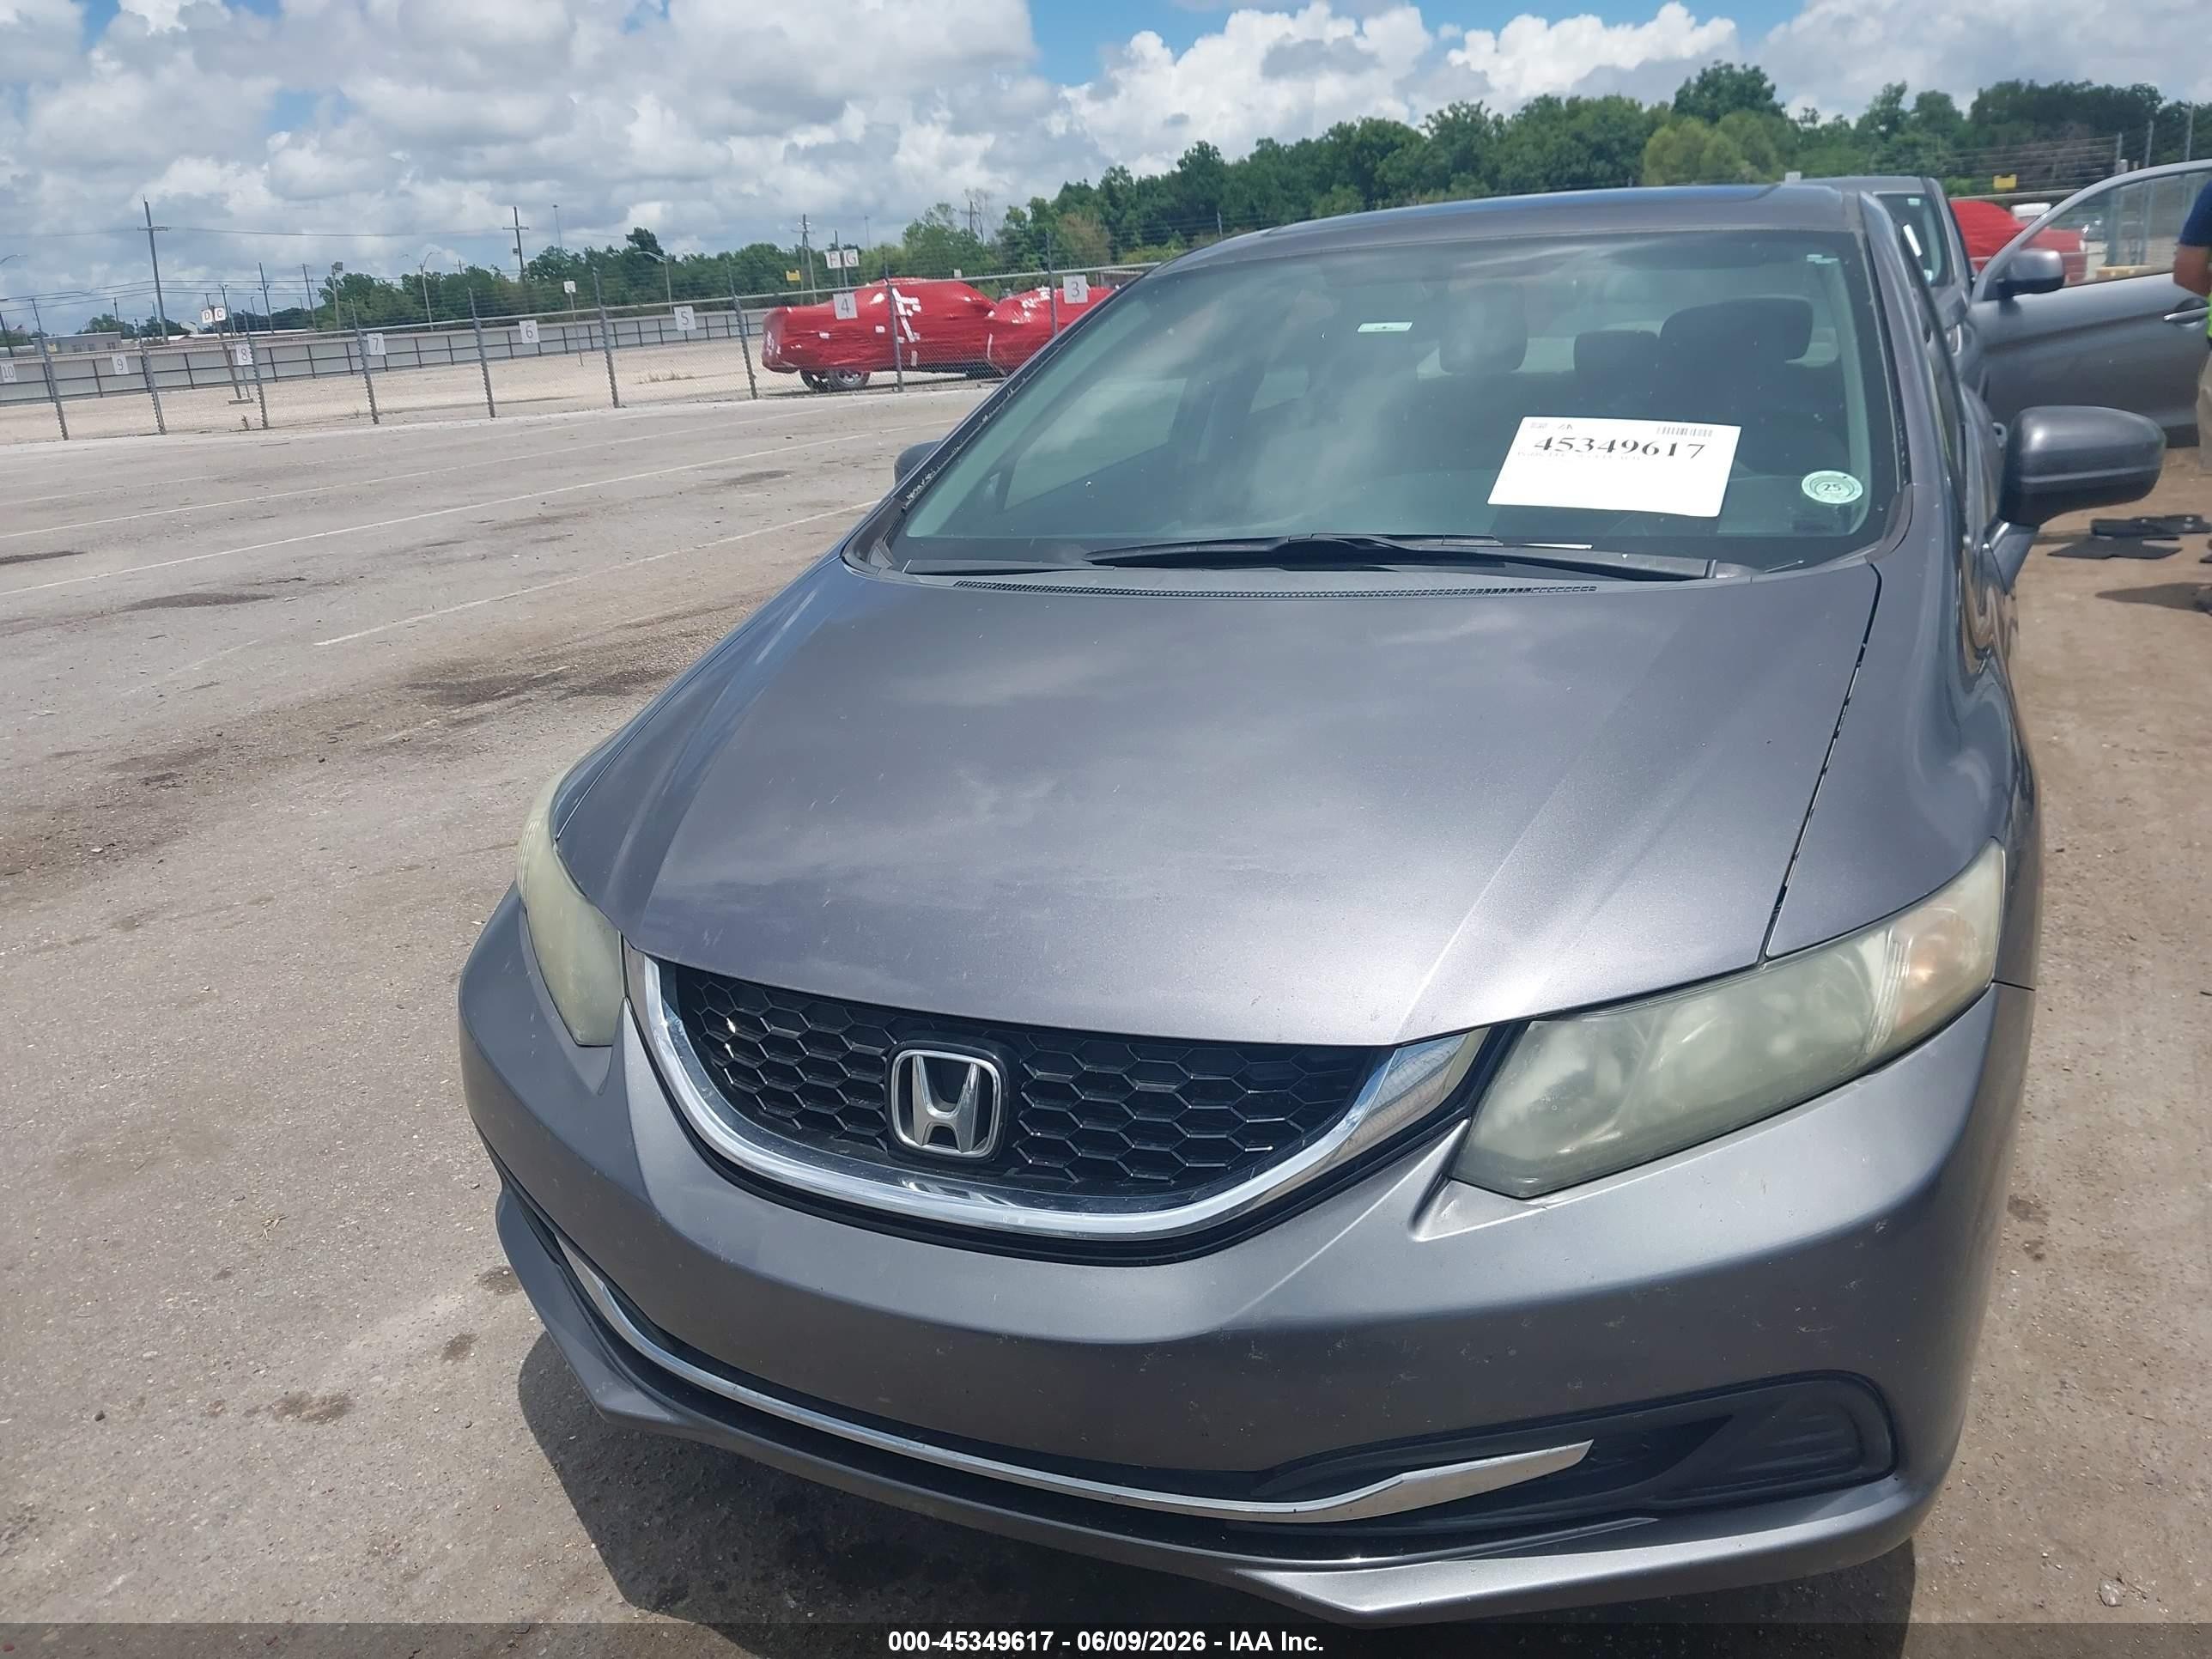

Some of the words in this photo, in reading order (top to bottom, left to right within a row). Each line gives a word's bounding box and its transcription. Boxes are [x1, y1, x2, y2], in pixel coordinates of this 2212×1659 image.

[846, 251, 857, 265] G
[1071, 281, 1080, 298] 3
[841, 298, 851, 313] 4
[204, 311, 210, 320] D
[216, 309, 222, 319] C
[680, 310, 689, 325] 5
[526, 325, 534, 338] 6
[371, 337, 379, 351] 7
[240, 348, 248, 361] 8
[1, 364, 15, 379] 10
[116, 358, 125, 371] 9
[1533, 435, 1706, 459] 45349617
[1822, 483, 1842, 491] 25
